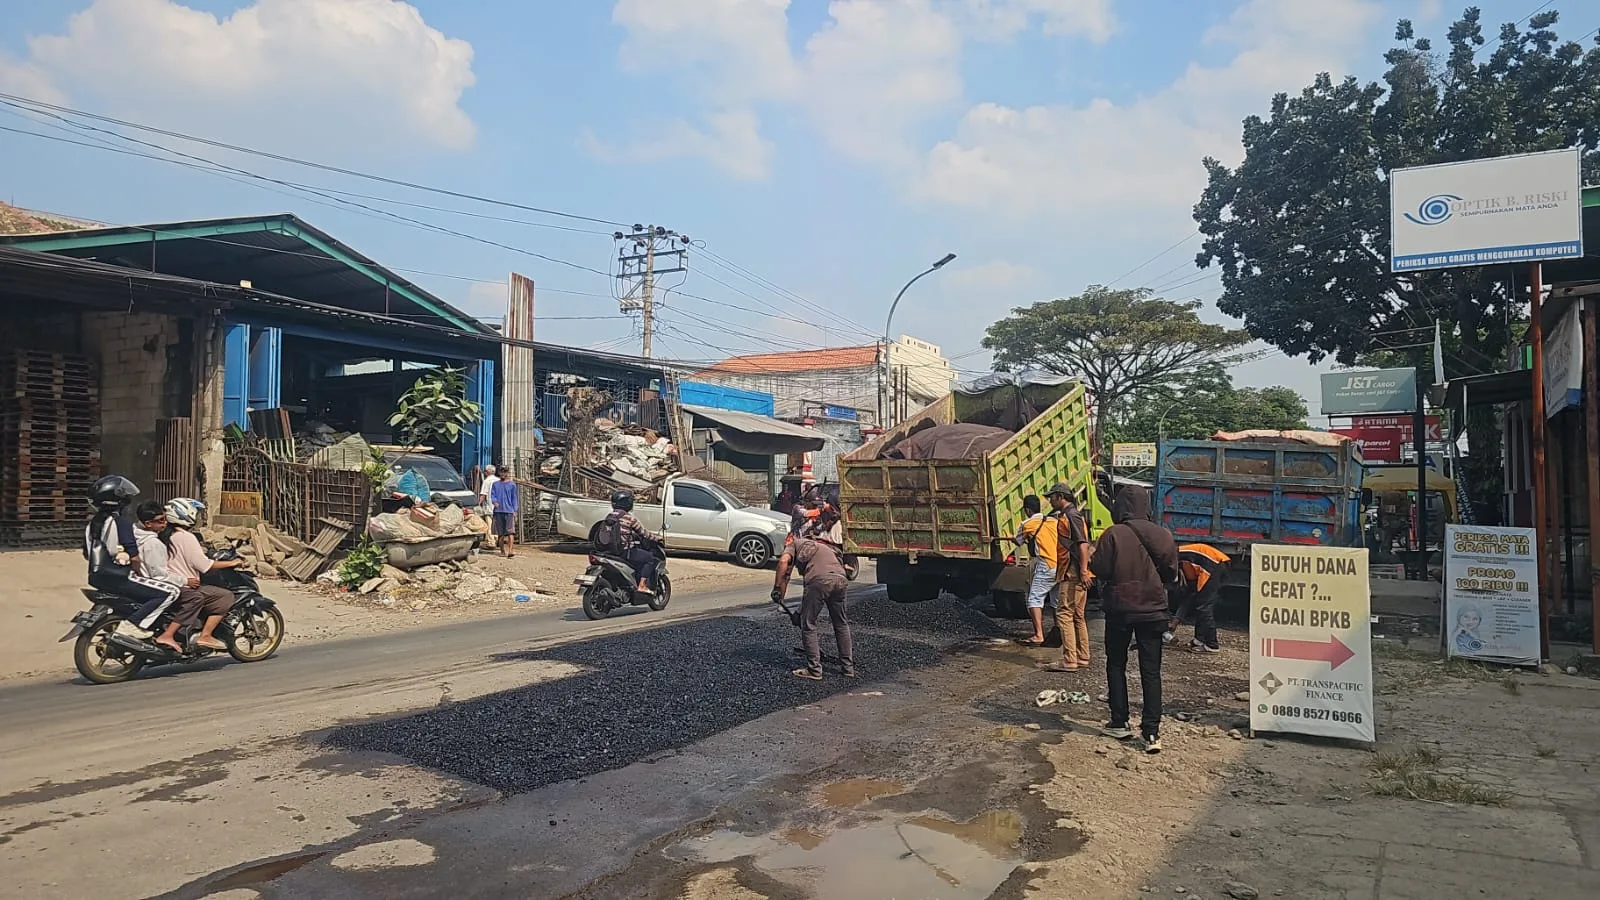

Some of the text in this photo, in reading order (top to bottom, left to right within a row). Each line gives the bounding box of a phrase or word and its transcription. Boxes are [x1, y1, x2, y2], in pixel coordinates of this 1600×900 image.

[1451, 191, 1569, 212] OPTIK B. RISKI
[1460, 207, 1514, 217] SEMPURNAKAN
[1396, 246, 1577, 268] PERIKSA MATA GRATIS MENGGUNAKAN KOMPUTER
[1341, 376, 1378, 390] J&T
[1453, 532, 1530, 544] PERIKSA MATA
[1454, 541, 1510, 555] GRATIS
[1261, 554, 1357, 576] BUTUH DANA
[1467, 567, 1516, 580] PROMO
[1260, 580, 1306, 600] CEPAT
[1455, 578, 1479, 590] 100
[1481, 580, 1514, 592] RIBU
[1260, 606, 1351, 629] GADAI BPKB
[1287, 677, 1364, 692] PT. TRANSPACIFIC
[1306, 690, 1344, 702] FINANCE
[1272, 704, 1363, 724] 0889 8527 6966
